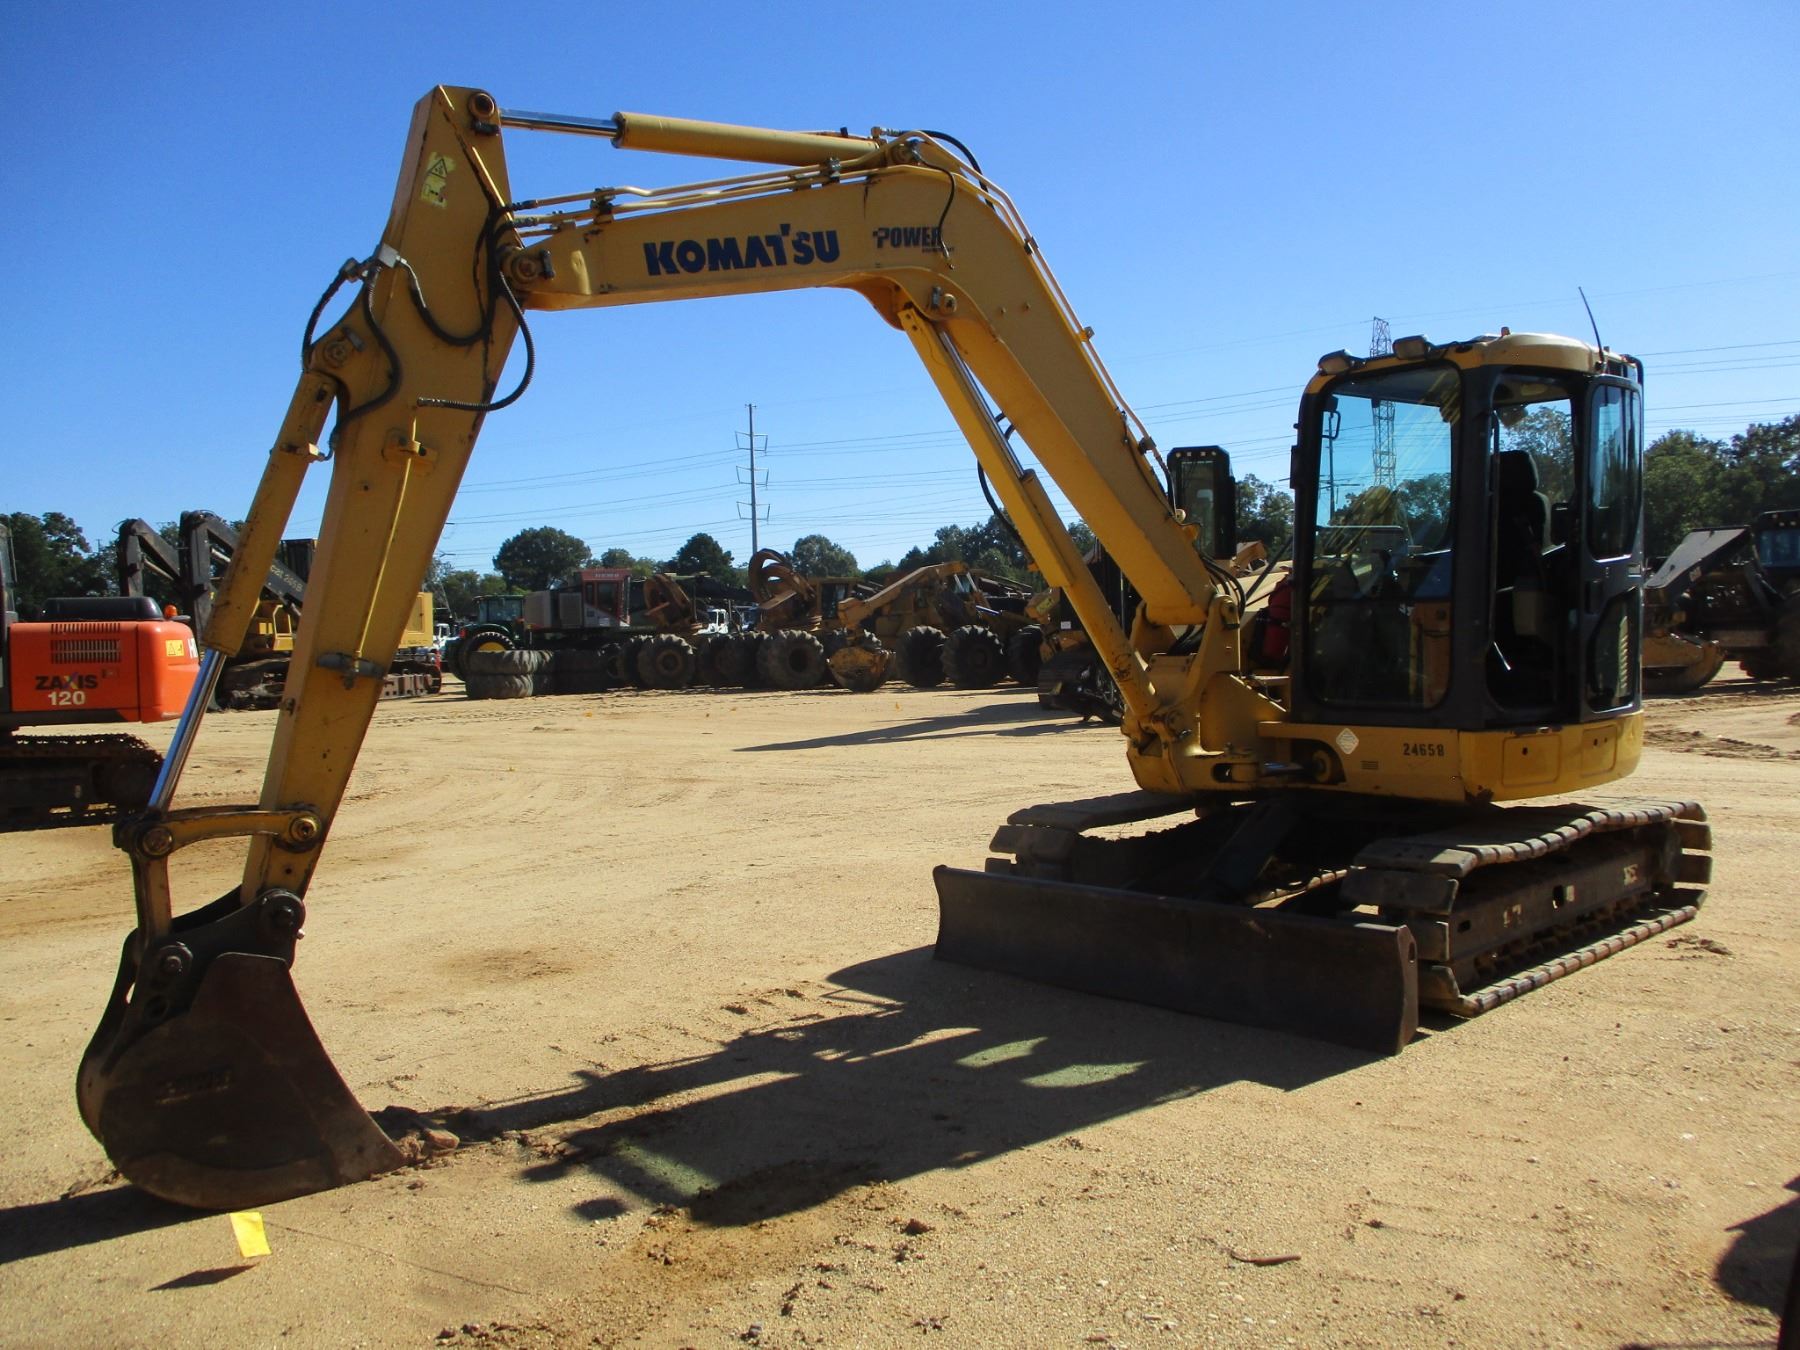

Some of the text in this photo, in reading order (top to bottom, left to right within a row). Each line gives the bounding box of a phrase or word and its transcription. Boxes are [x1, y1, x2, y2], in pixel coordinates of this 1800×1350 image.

[873, 226, 942, 248] POWER
[643, 223, 840, 277] KOMATSU
[35, 672, 98, 690] ZAXIS
[48, 690, 86, 706] 120
[1402, 742, 1445, 757] 24658
